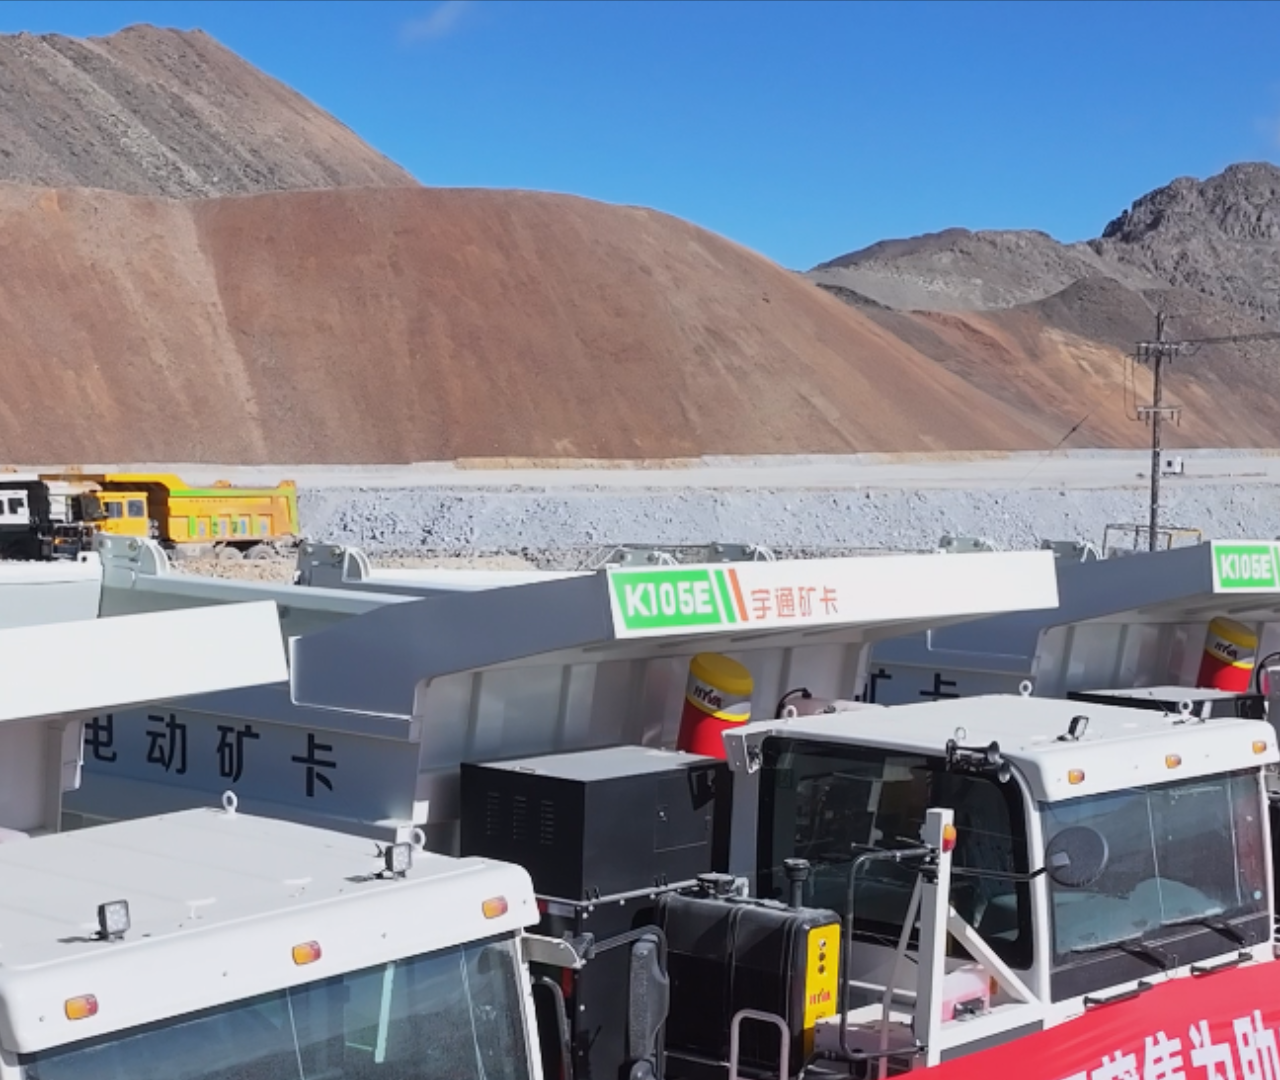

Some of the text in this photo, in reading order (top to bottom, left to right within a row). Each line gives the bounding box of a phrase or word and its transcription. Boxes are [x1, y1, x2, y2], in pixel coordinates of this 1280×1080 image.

[1220, 553, 1273, 579] K105E
[624, 581, 839, 620] K105E 宇通矿卡
